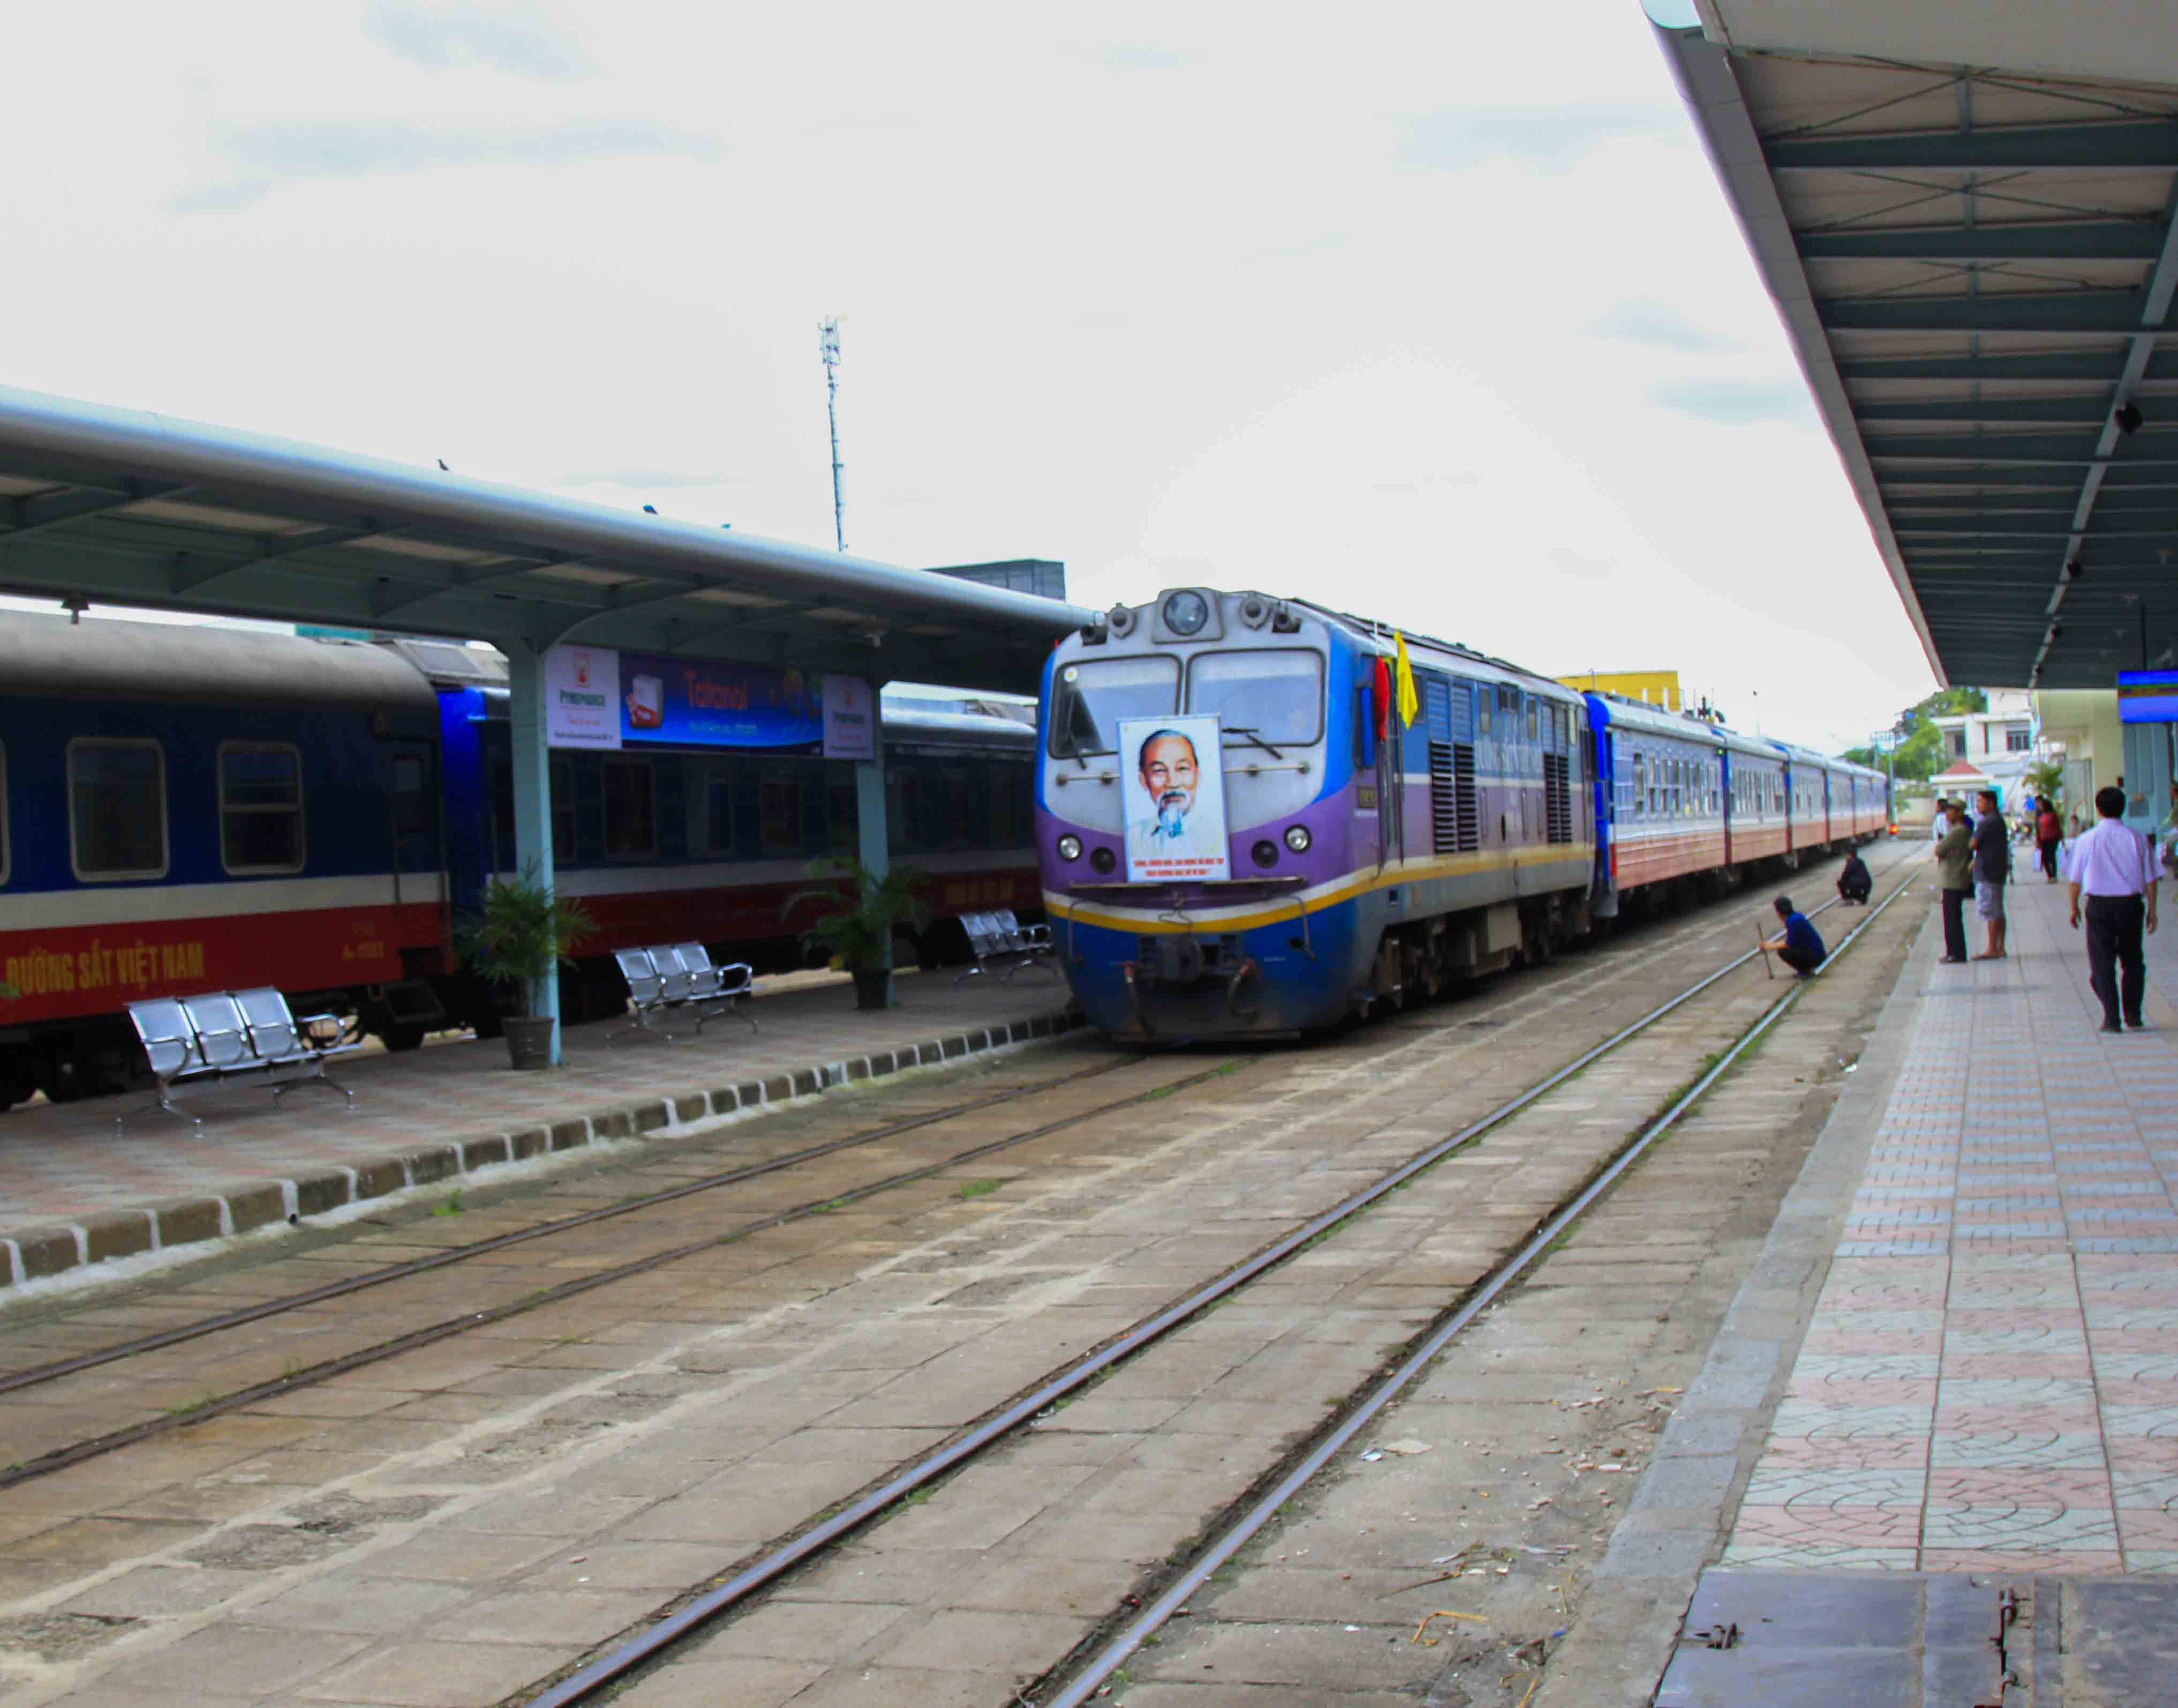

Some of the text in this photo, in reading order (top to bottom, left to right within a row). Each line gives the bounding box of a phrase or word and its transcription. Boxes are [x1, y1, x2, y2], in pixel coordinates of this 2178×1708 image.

[78, 938, 112, 989] SẮT
[116, 939, 159, 992] VIỆT
[162, 942, 205, 980] NAM
